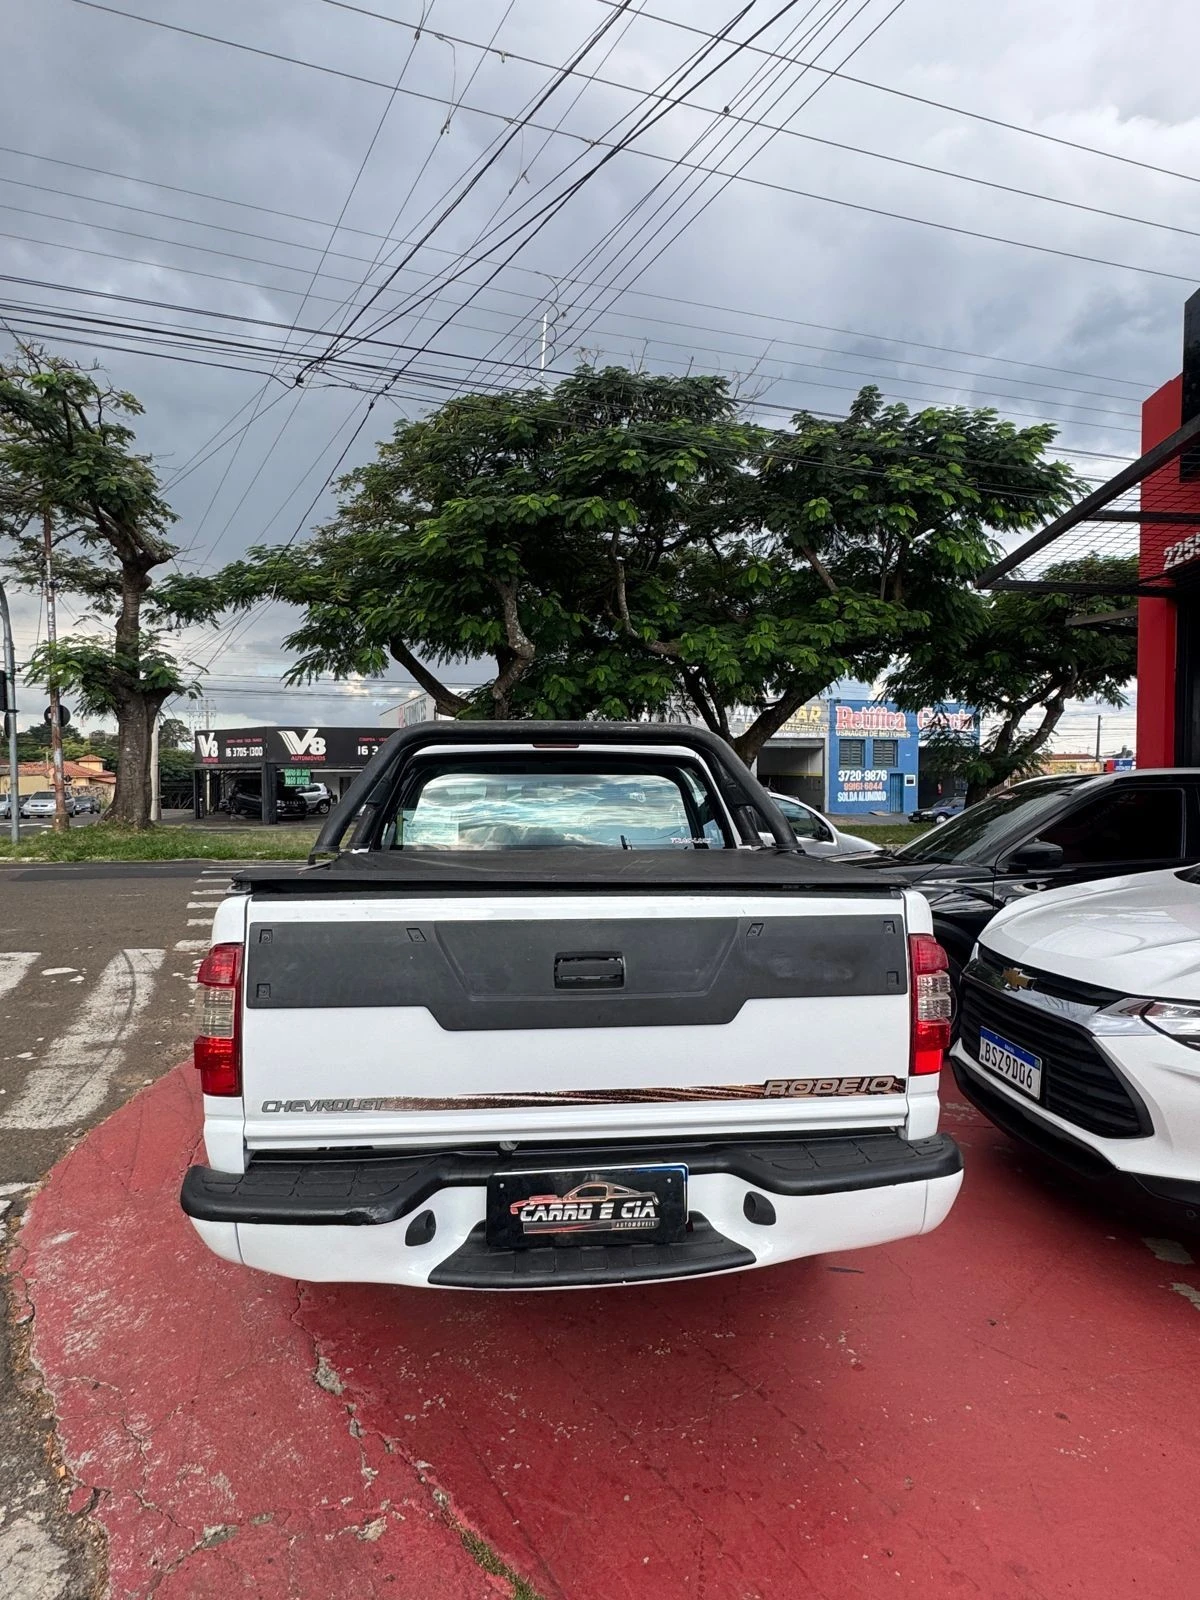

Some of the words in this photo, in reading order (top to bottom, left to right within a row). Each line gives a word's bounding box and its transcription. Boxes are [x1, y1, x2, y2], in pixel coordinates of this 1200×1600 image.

[197, 732, 219, 758] V8
[277, 728, 327, 756] V8
[357, 745, 369, 756] 16
[838, 769, 888, 782] 3720-9876
[984, 1041, 1033, 1089] BSZ9D06
[764, 1076, 895, 1096] RODEIO
[261, 1099, 384, 1112] CHEVROLET
[520, 1203, 594, 1222] CARRO
[599, 1202, 614, 1219] E
[620, 1200, 656, 1218] CIA
